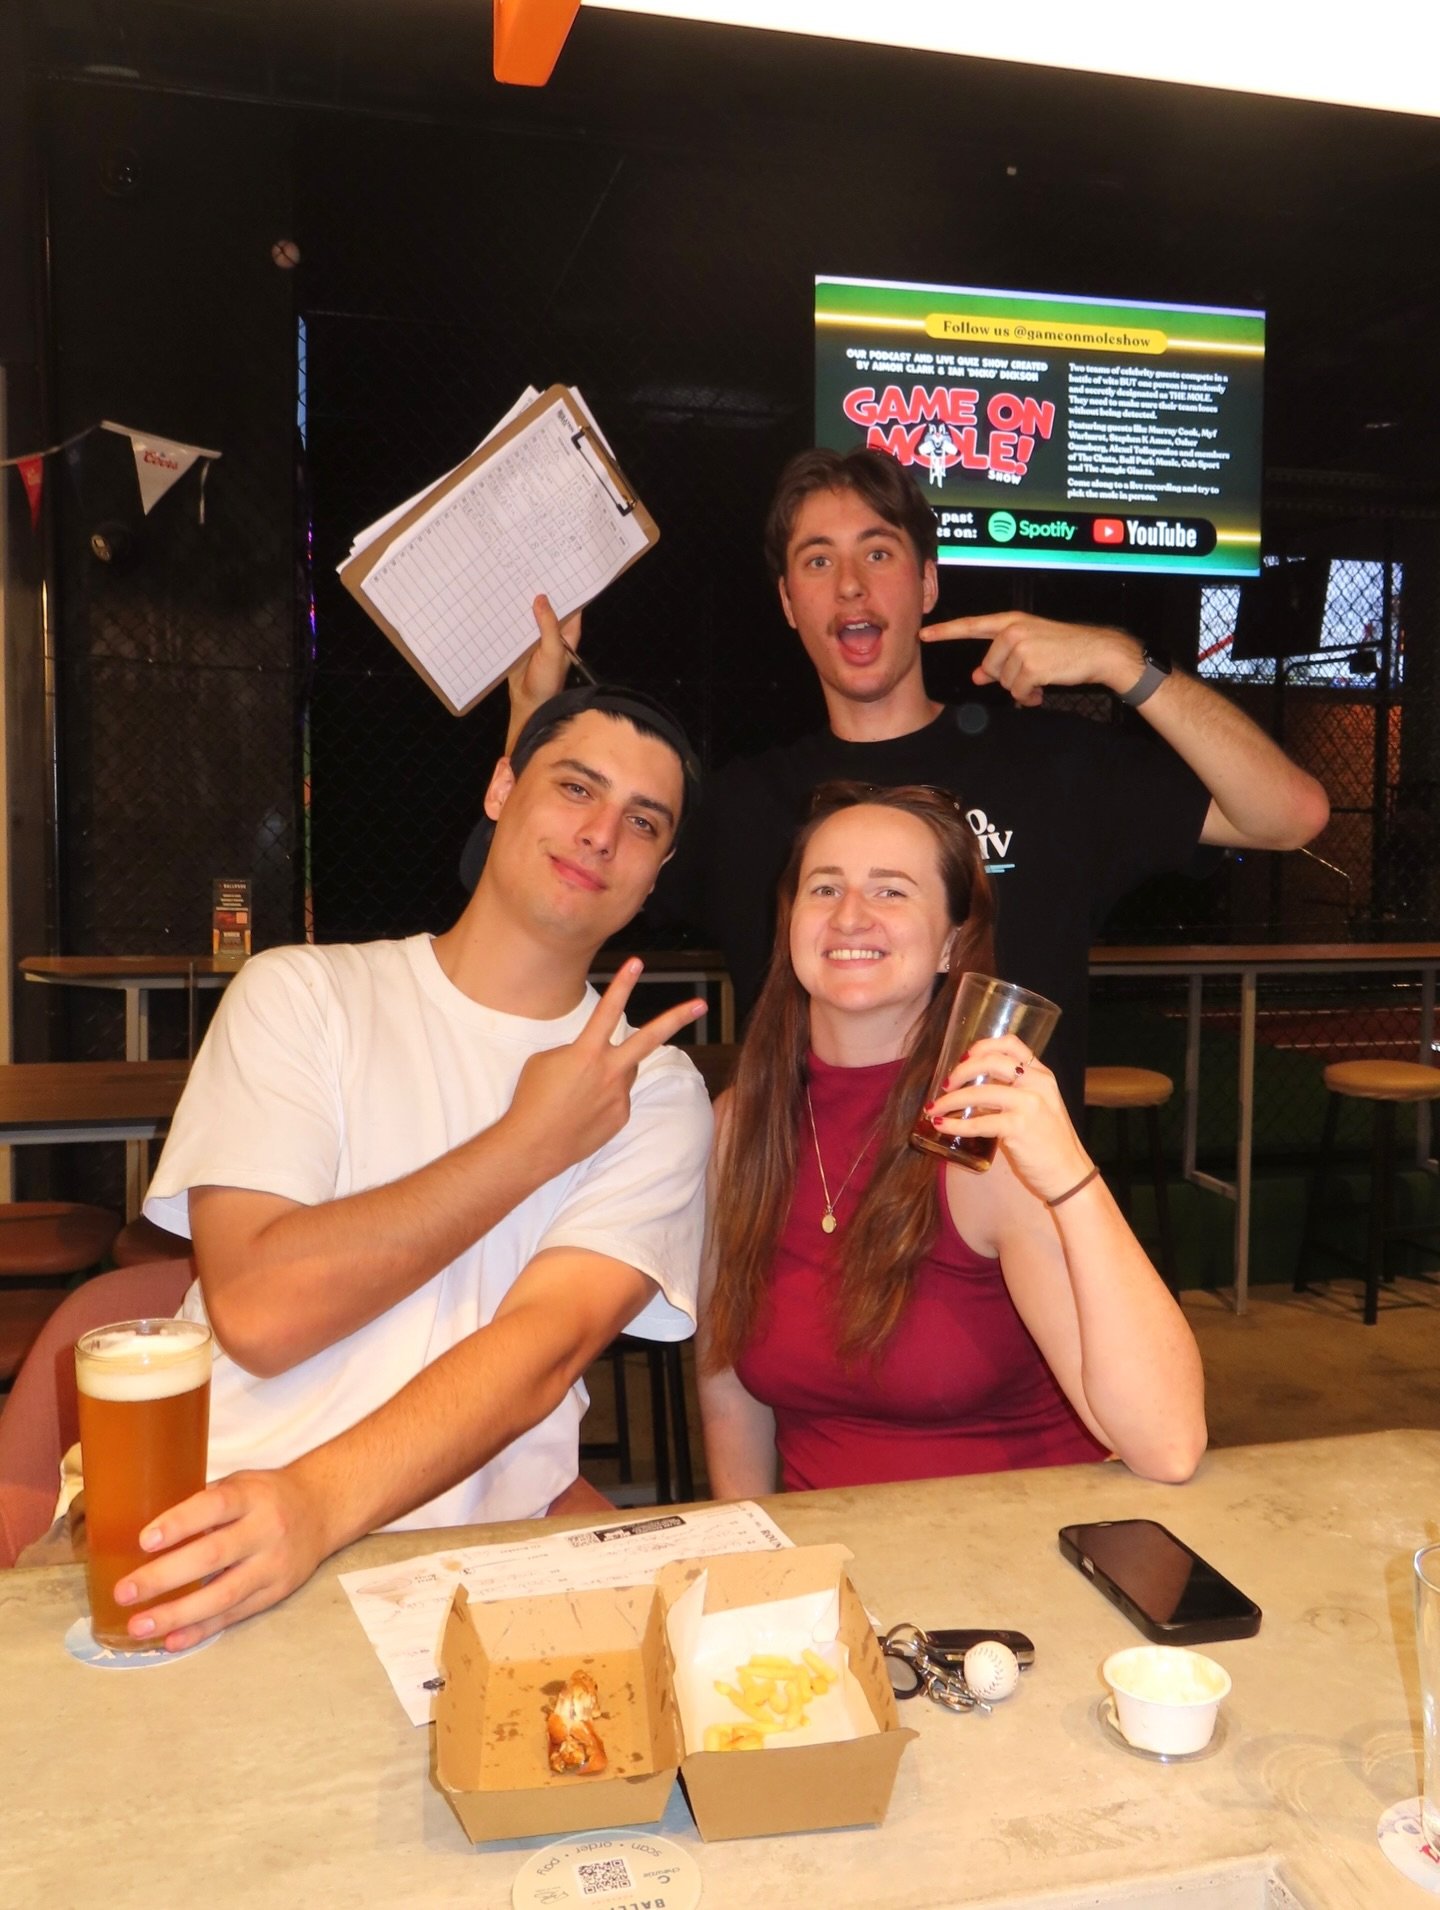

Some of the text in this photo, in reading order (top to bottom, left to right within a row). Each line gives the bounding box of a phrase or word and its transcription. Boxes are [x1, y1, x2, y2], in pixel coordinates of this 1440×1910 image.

[943, 321, 1150, 347] Follow us @gameonmoleshow
[846, 348, 1048, 371] OUR PODCAST AND LIVE QUIZ SHOW CREATED
[856, 360, 869, 370] BY
[905, 364, 934, 374] CLARK
[938, 366, 945, 375] &
[948, 367, 965, 376] IAN
[1000, 370, 1039, 382] DICKSON
[1069, 363, 1085, 373] Two
[1112, 366, 1120, 376] of
[1121, 367, 1154, 379] celebrity
[1156, 369, 1180, 381] guests
[1181, 371, 1214, 383] compete
[1215, 373, 1222, 382] in
[1069, 374, 1092, 384] battle
[1093, 376, 1102, 385] of
[1103, 376, 1119, 386] wits
[1120, 377, 1137, 387] BUT
[1153, 382, 1179, 391] person
[1181, 381, 1188, 390] is
[1189, 382, 1226, 394] randomly
[1069, 384, 1083, 394] and
[1085, 385, 1116, 397] secretly
[1117, 387, 1157, 400] designated
[1169, 390, 1186, 400] THE
[1187, 391, 1212, 402] MOLE.
[843, 385, 1055, 439] GAME ON
[1069, 394, 1218, 412] They need to make sure their team loses
[1068, 406, 1157, 419] without being detected.
[1068, 421, 1107, 433] Featuring
[1108, 423, 1132, 435] guests
[1149, 425, 1177, 437] Murray
[1178, 427, 1200, 439] Cook,
[1109, 432, 1141, 444] Stephen
[1142, 434, 1149, 444] K
[1149, 434, 1174, 446] Amos,
[867, 424, 1035, 475] MOLE!
[1179, 448, 1194, 457] and
[1195, 448, 1229, 459] members
[1068, 452, 1220, 470] of The Chats, Ball Park Music, Cub Sport
[1068, 463, 1154, 475] and The Jungle Giants.
[988, 470, 1022, 485] SHOW
[1068, 477, 1090, 487] Come
[1091, 478, 1113, 489] along
[1114, 479, 1122, 489] to
[1130, 480, 1143, 490] live
[1144, 481, 1181, 493] recording
[1182, 483, 1197, 493] and
[1198, 484, 1209, 494] try
[1211, 484, 1219, 494] to
[1068, 488, 1157, 502] pick the mole in person.
[941, 511, 974, 526] past
[936, 526, 978, 539] es on:
[1019, 520, 1076, 540] Spotify
[1126, 520, 1197, 548] YouTube
[535, 1841, 662, 1877] scan order pay
